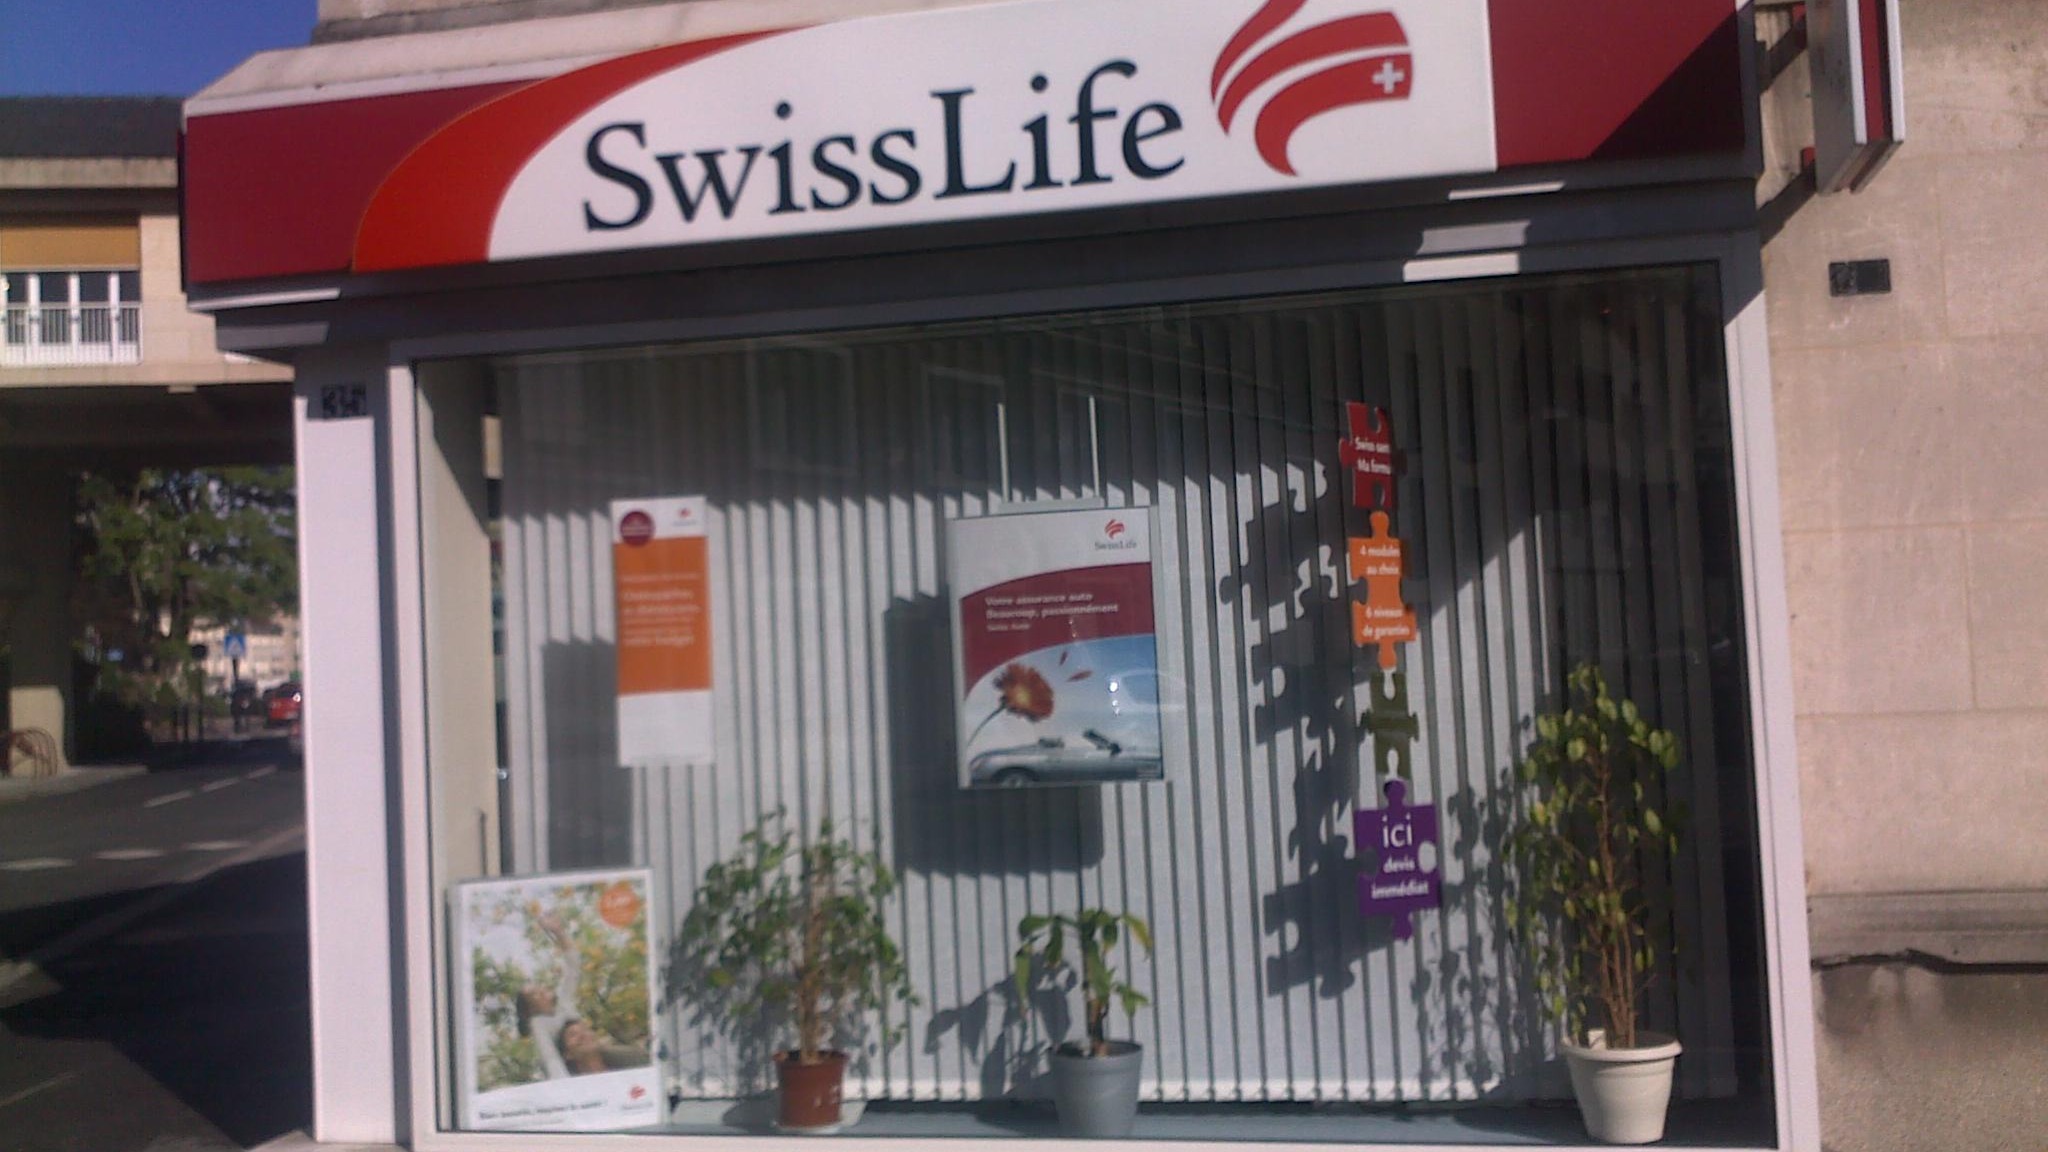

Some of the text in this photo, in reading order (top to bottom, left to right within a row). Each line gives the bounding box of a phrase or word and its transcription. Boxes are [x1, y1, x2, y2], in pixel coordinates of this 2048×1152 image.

[583, 60, 1186, 232] SwissLife
[1016, 594, 1066, 605] assurance
[1068, 592, 1093, 603] auto
[1041, 603, 1119, 618] passionnément
[1382, 812, 1413, 849] ici
[1383, 855, 1415, 874] devis
[1371, 879, 1429, 900] immédiat
